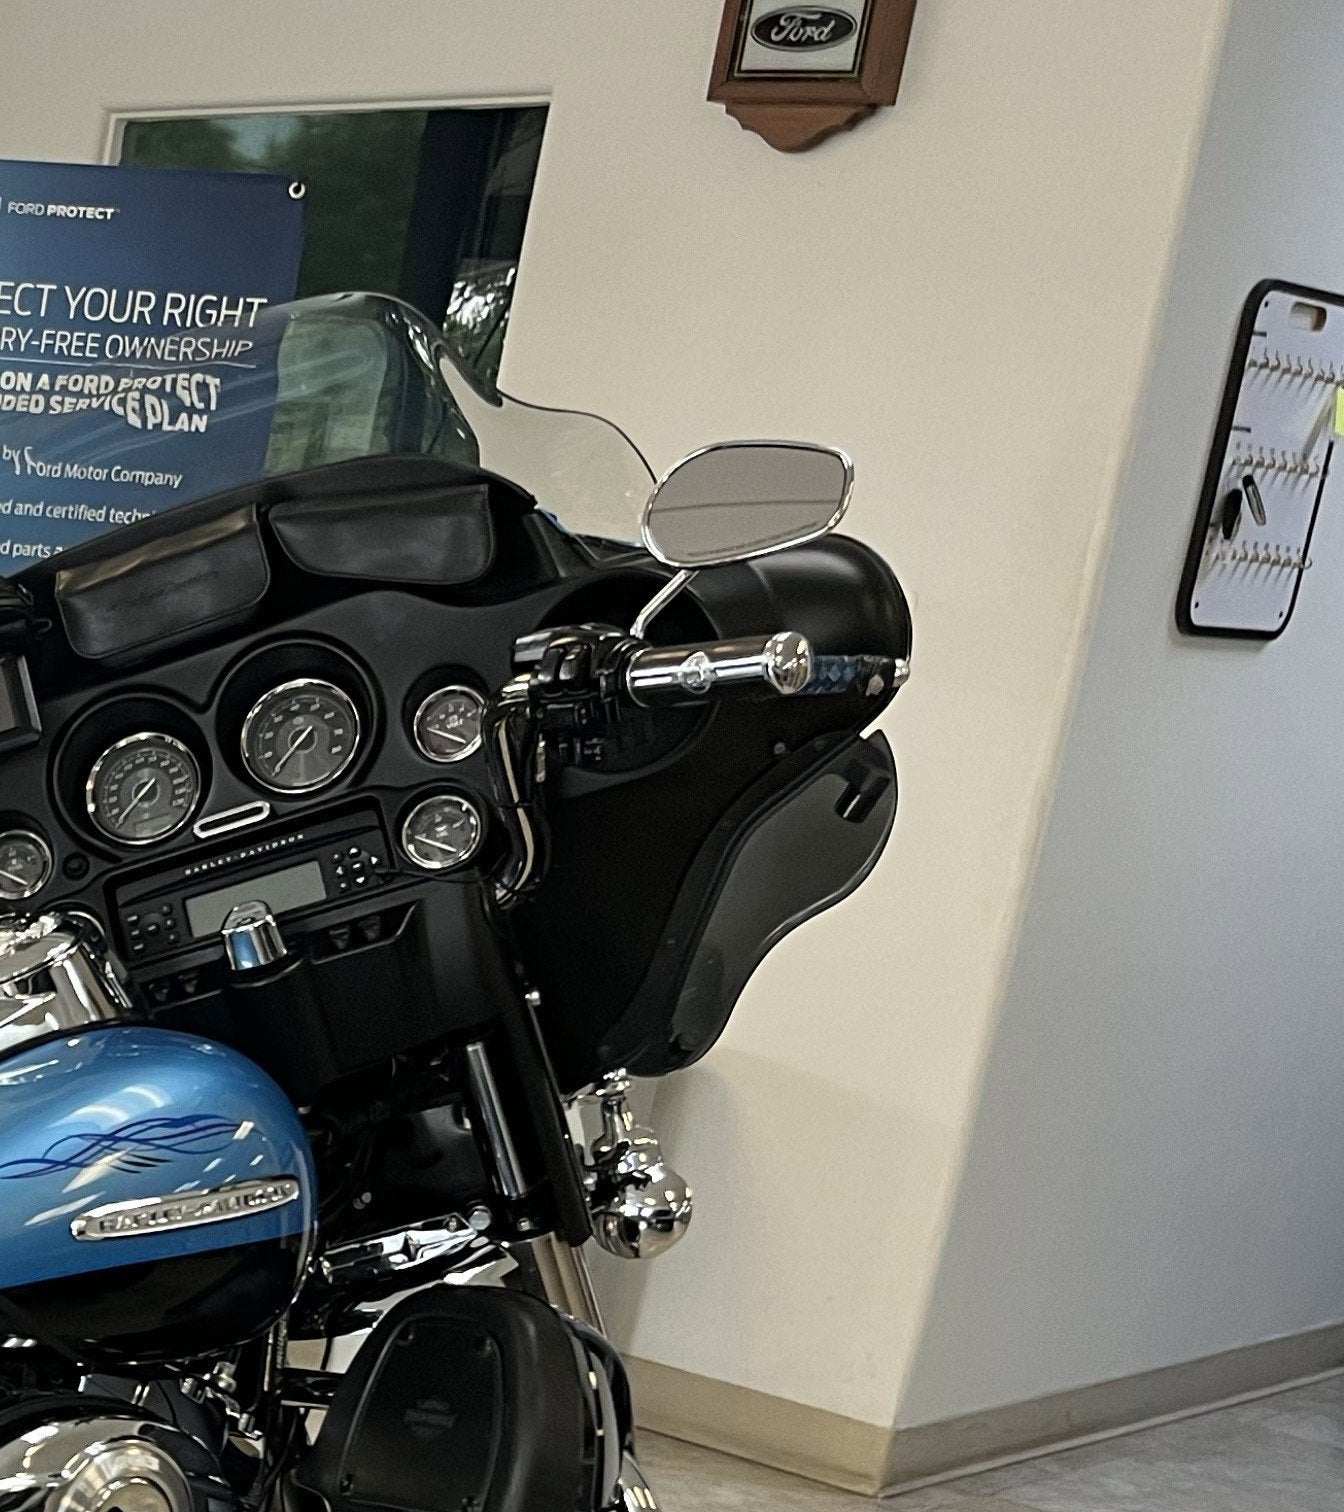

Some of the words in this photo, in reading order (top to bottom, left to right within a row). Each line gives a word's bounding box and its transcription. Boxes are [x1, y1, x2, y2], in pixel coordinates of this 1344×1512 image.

[769, 10, 837, 43] Ford
[7, 201, 45, 217] FORD
[46, 204, 116, 220] PROTECT
[64, 284, 157, 326] YOUR
[162, 292, 268, 328] RIGHT
[105, 334, 254, 362] OWNERSHIP
[0, 370, 32, 392] ON
[35, 372, 52, 392] A
[54, 374, 115, 396] FORD
[117, 372, 221, 412] PROTECT
[48, 392, 143, 430] SERVICE
[145, 395, 209, 434] PLAN
[1, 444, 22, 476] by
[23, 446, 62, 479] Ford
[64, 464, 109, 482] Motor
[110, 465, 184, 489] Company
[13, 500, 44, 518] and
[45, 503, 106, 524] certified
[12, 543, 52, 560] parts
